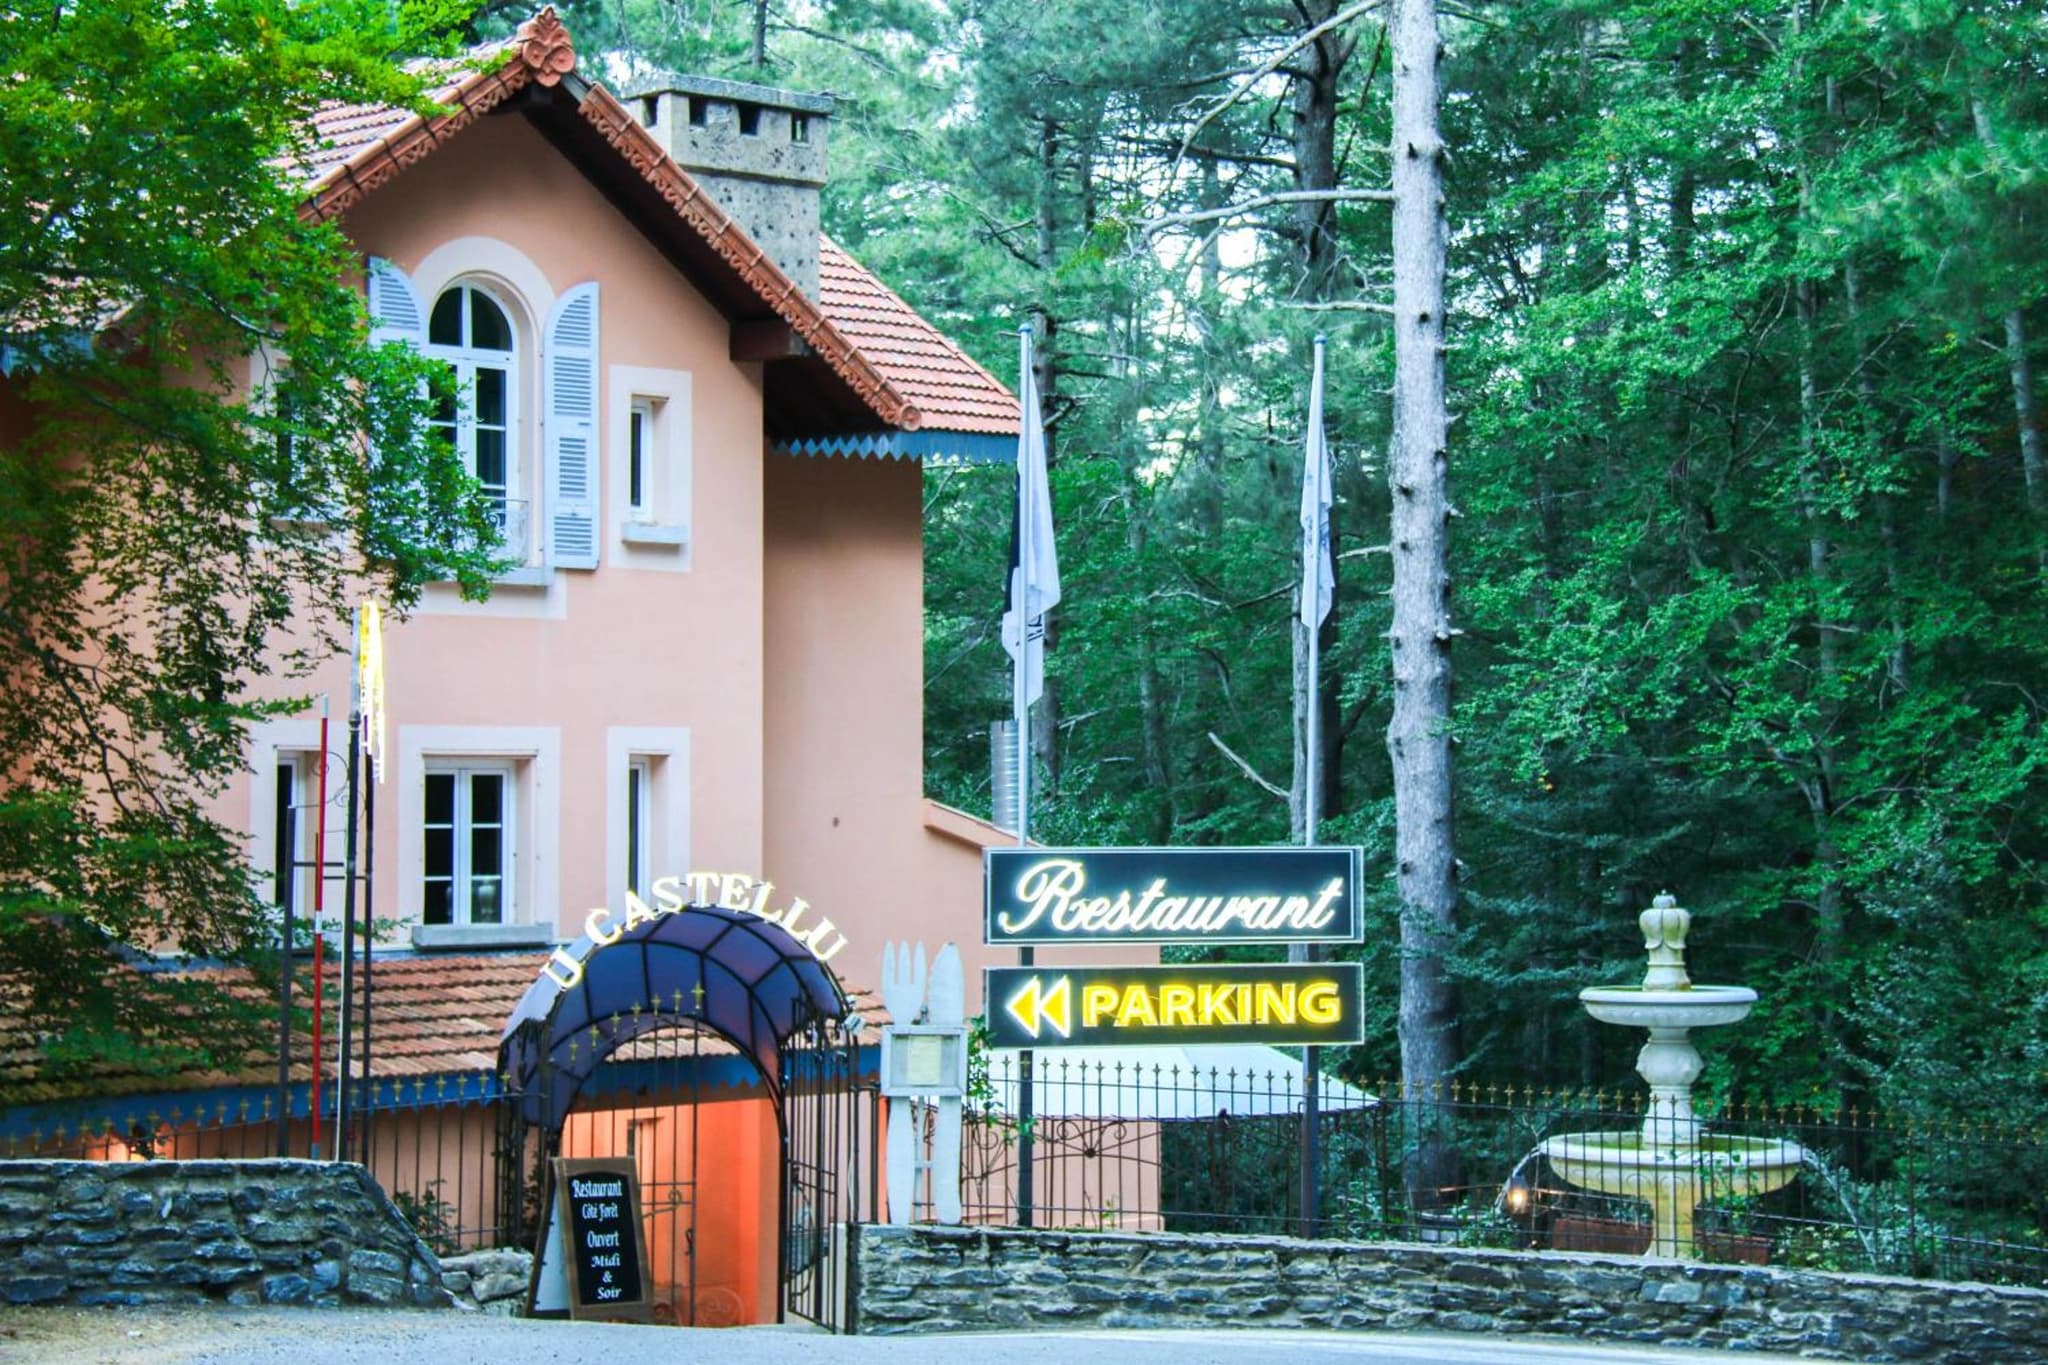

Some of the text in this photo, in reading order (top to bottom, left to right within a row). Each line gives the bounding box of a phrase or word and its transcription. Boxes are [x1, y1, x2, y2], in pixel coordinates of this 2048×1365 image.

[999, 859, 1345, 934] Restaurant
[540, 872, 848, 990] U CASTELLU
[1082, 980, 1342, 1025] PARKING
[572, 1179, 622, 1197] Restaurant
[587, 1230, 619, 1248] Ouvert
[591, 1253, 621, 1268] Midi
[602, 1271, 613, 1283] &
[597, 1287, 621, 1299] Soir
